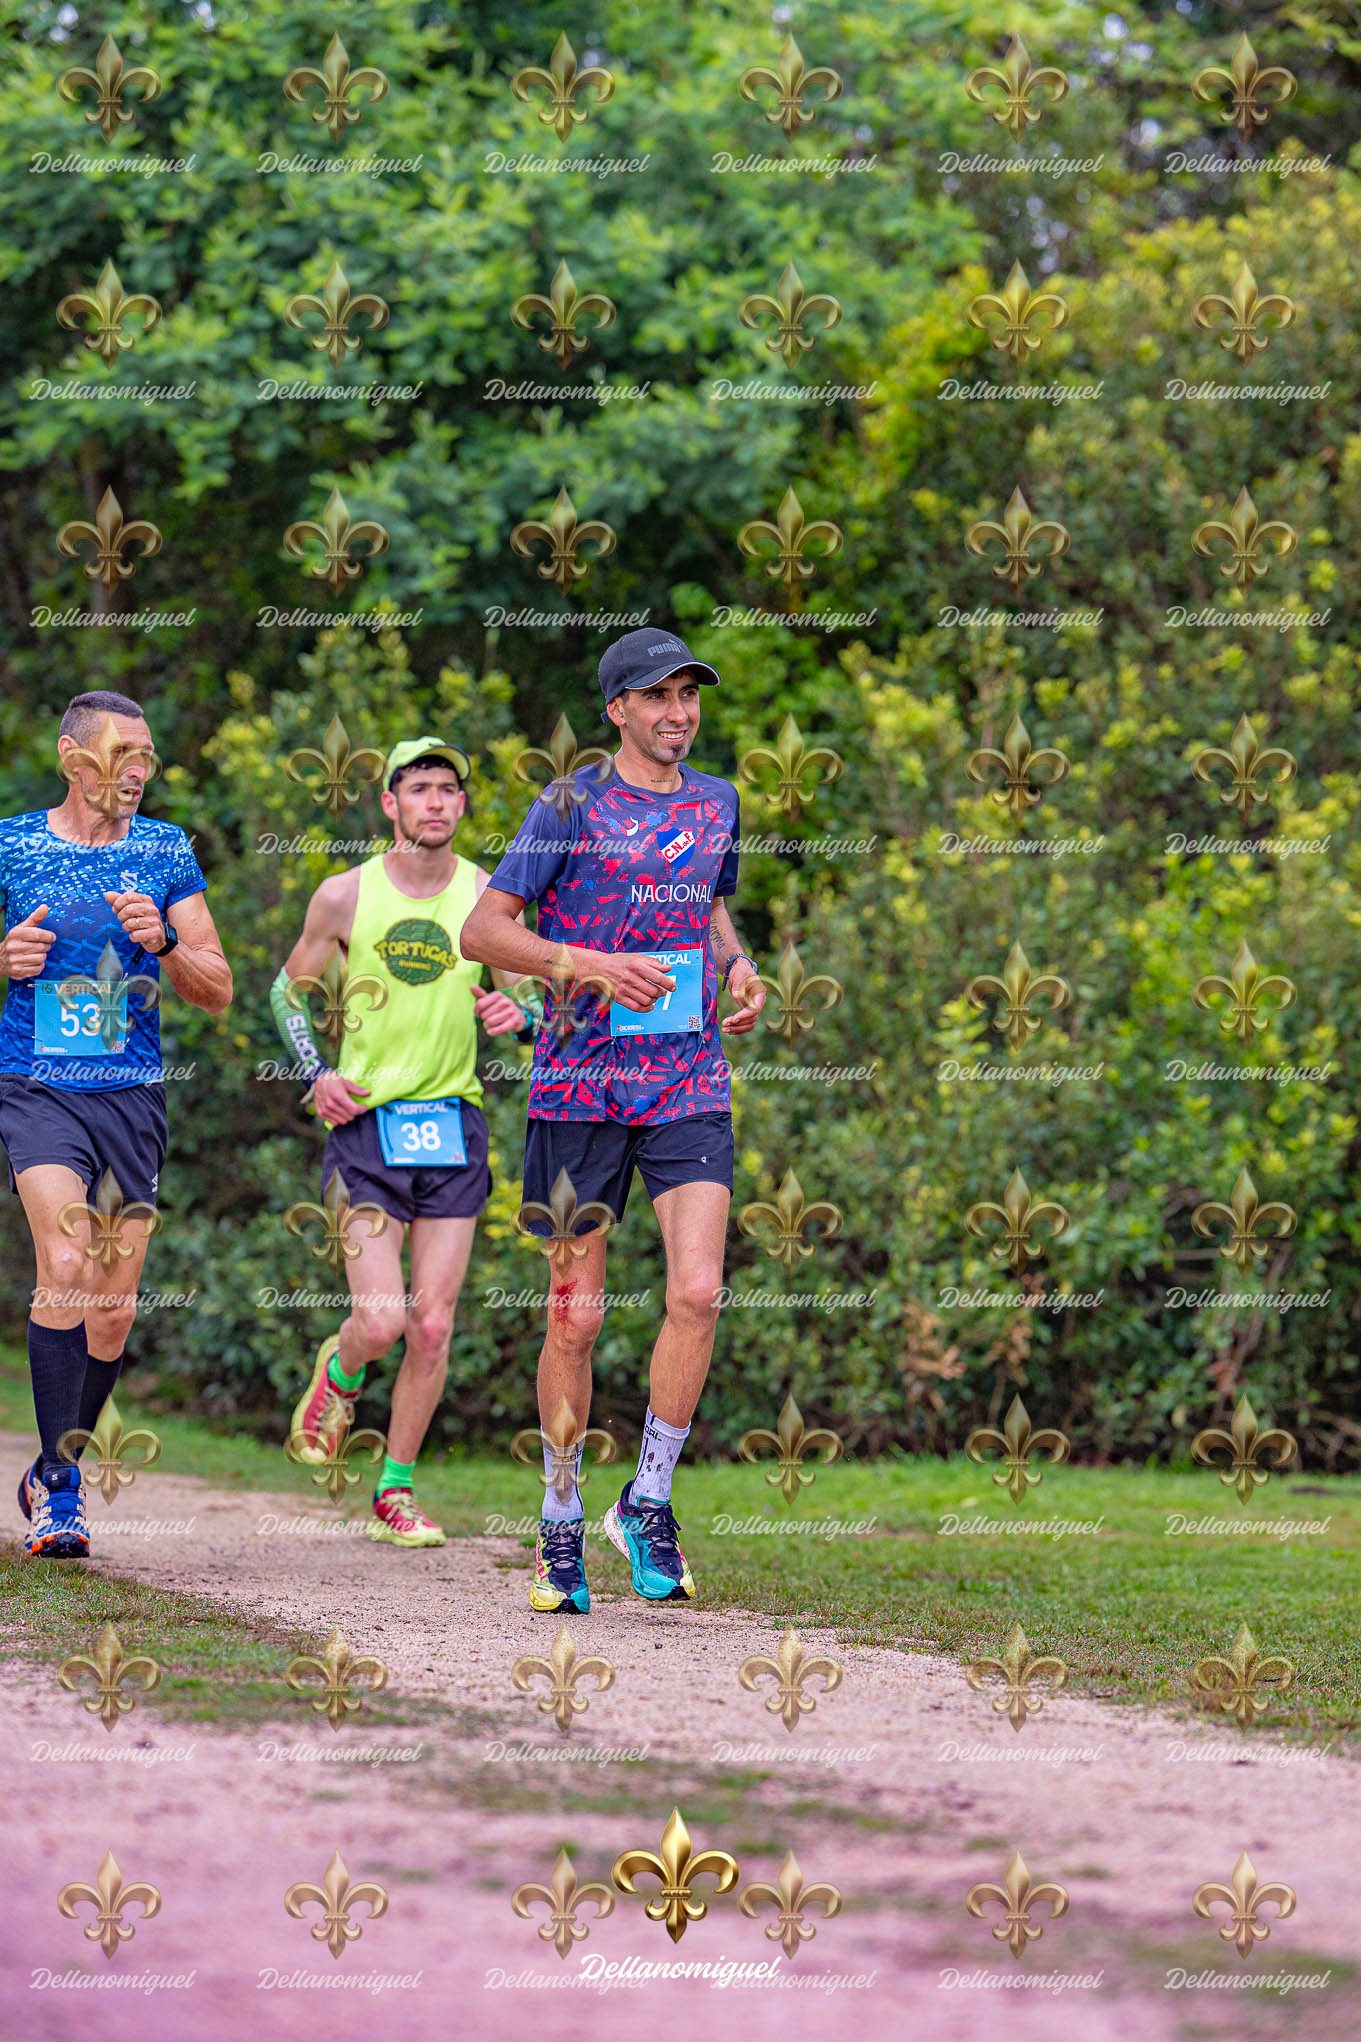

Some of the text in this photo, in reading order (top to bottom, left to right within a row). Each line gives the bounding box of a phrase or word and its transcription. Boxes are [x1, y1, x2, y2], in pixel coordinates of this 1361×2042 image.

[631, 883, 712, 903] NACIONAL
[374, 939, 457, 970] TORTUGAS
[54, 983, 114, 995] VERTICAL
[60, 1003, 101, 1037] 53
[394, 1101, 448, 1115] VERTICAL
[401, 1121, 441, 1152] 38
